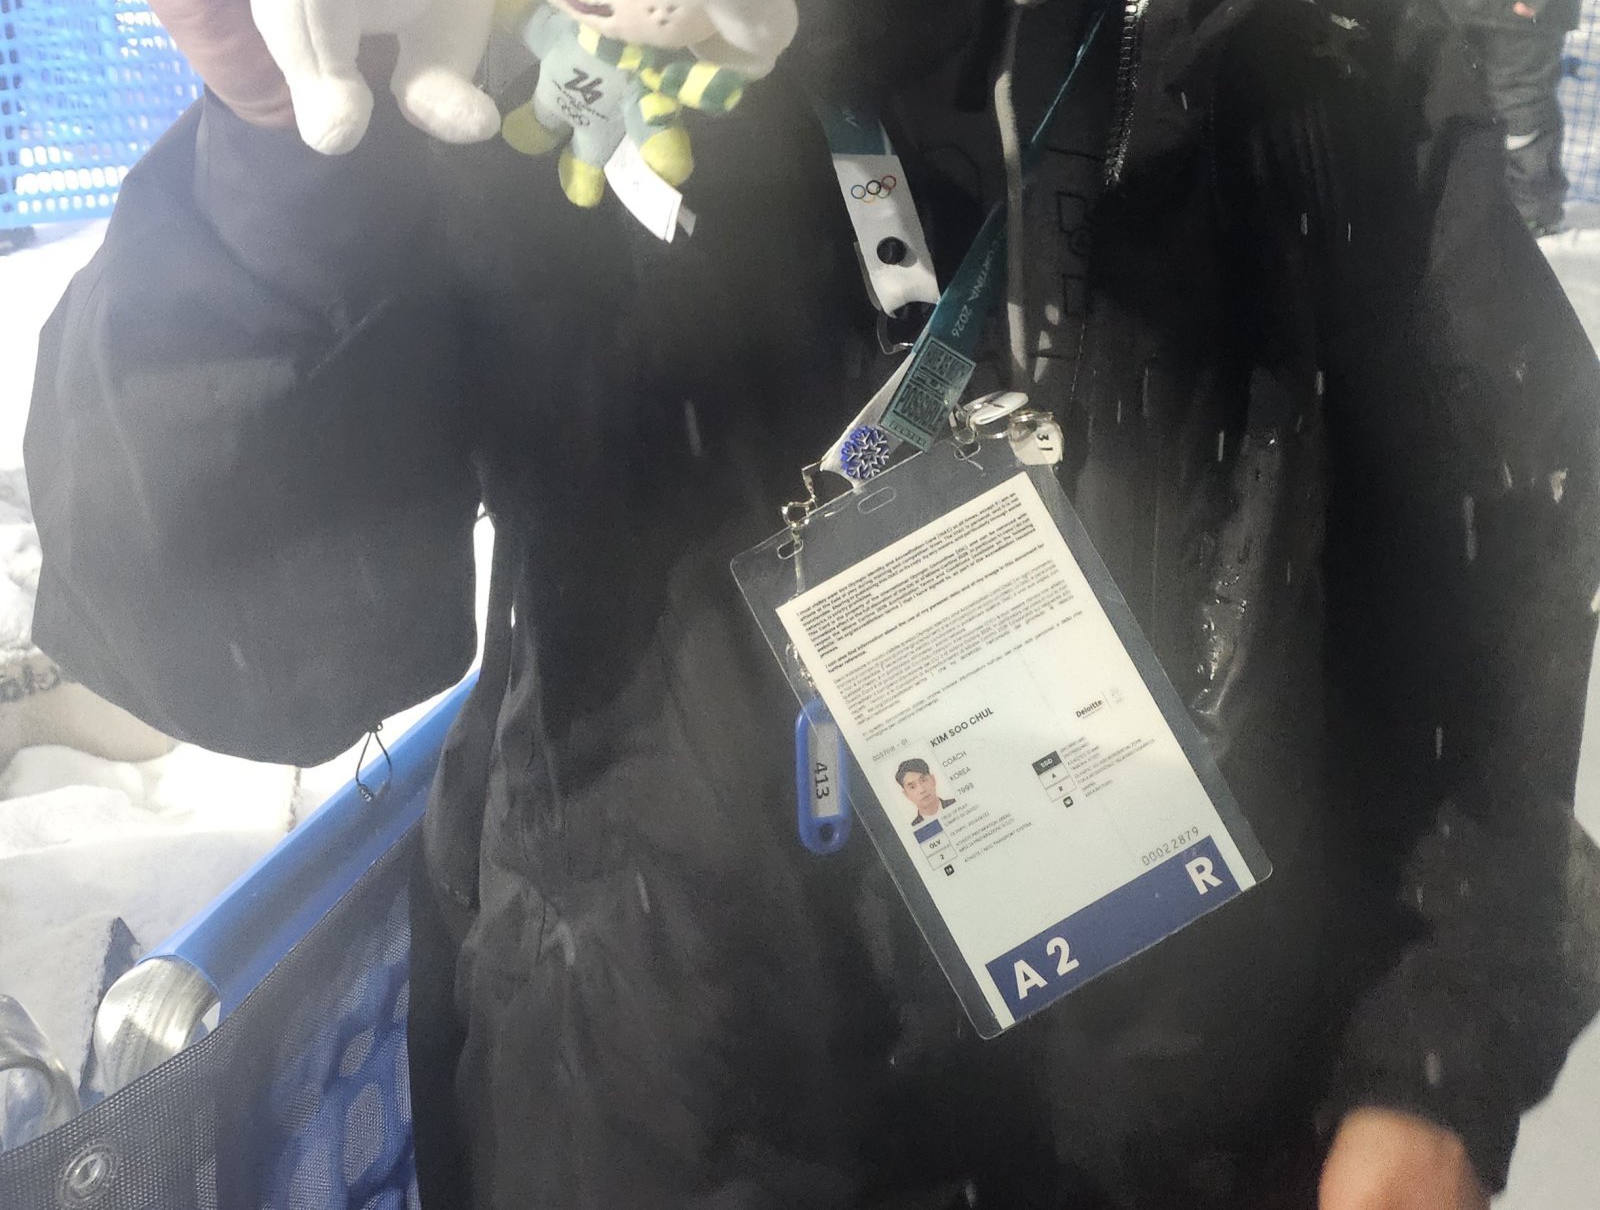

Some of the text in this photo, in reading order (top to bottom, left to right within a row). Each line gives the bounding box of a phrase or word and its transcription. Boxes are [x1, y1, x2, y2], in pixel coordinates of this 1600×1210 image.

[949, 304, 973, 338] 2026
[929, 706, 993, 747] KIM SOO CHUL
[941, 749, 967, 768] COACH
[948, 765, 971, 782] KOREA
[813, 761, 830, 800] 413
[928, 838, 942, 850] OLV
[1139, 825, 1201, 867] 00022879
[1185, 857, 1222, 894] R
[1014, 937, 1079, 999] A 2
